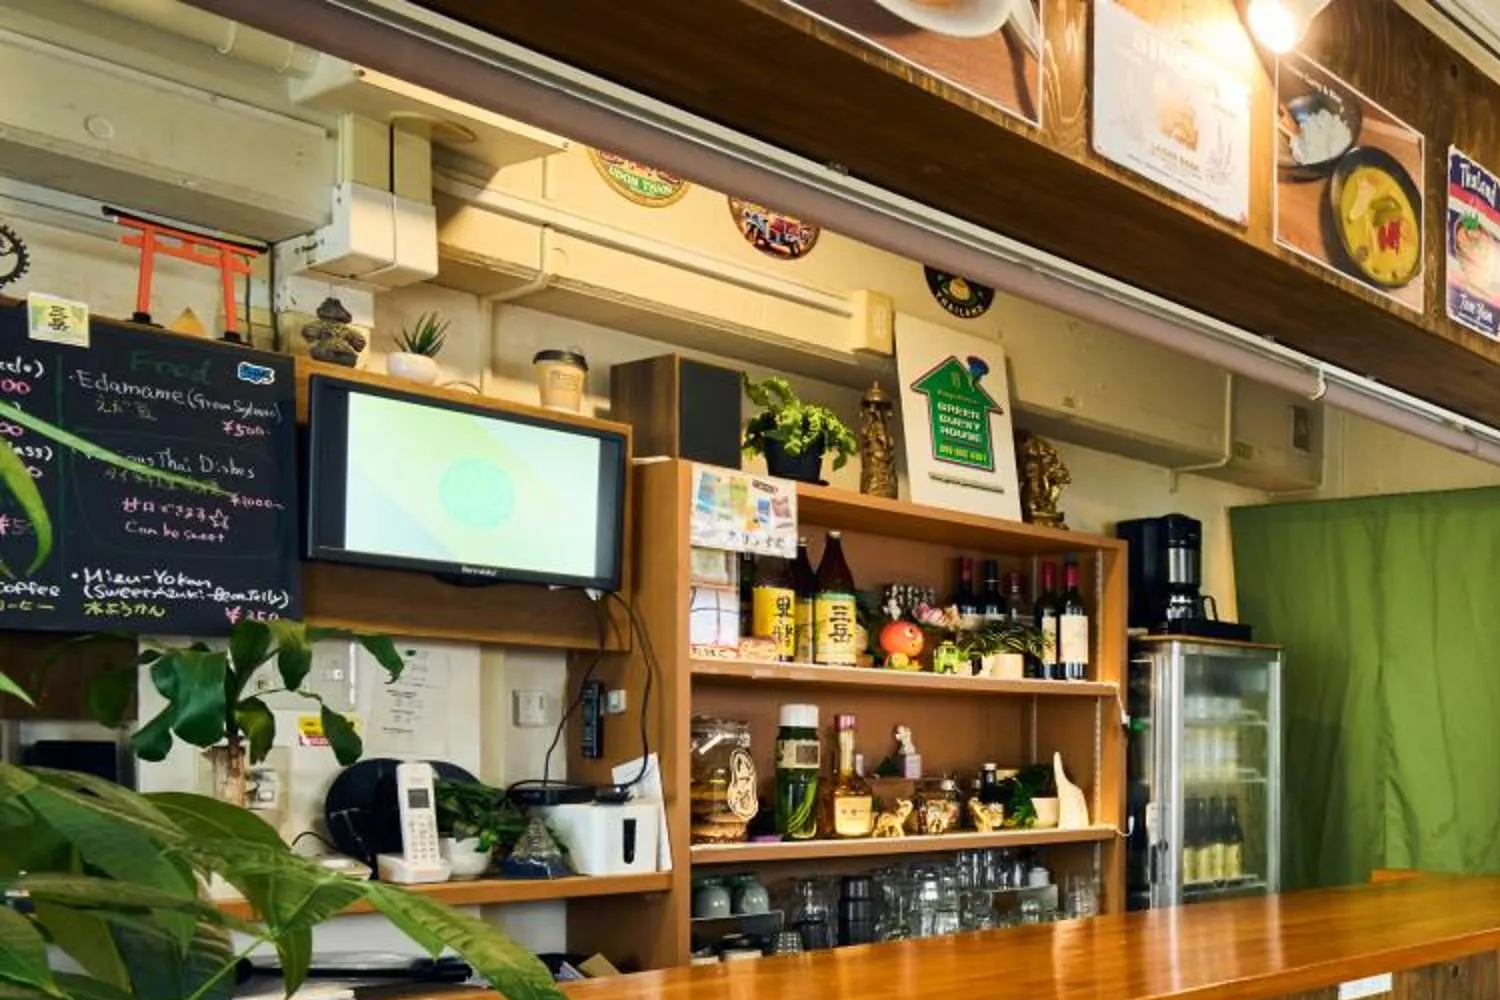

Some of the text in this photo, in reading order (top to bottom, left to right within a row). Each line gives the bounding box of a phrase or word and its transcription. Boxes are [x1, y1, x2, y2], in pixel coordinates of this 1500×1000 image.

[131, 351, 211, 384] Food
[76, 369, 185, 404] Edamame
[157, 448, 192, 473] Thai
